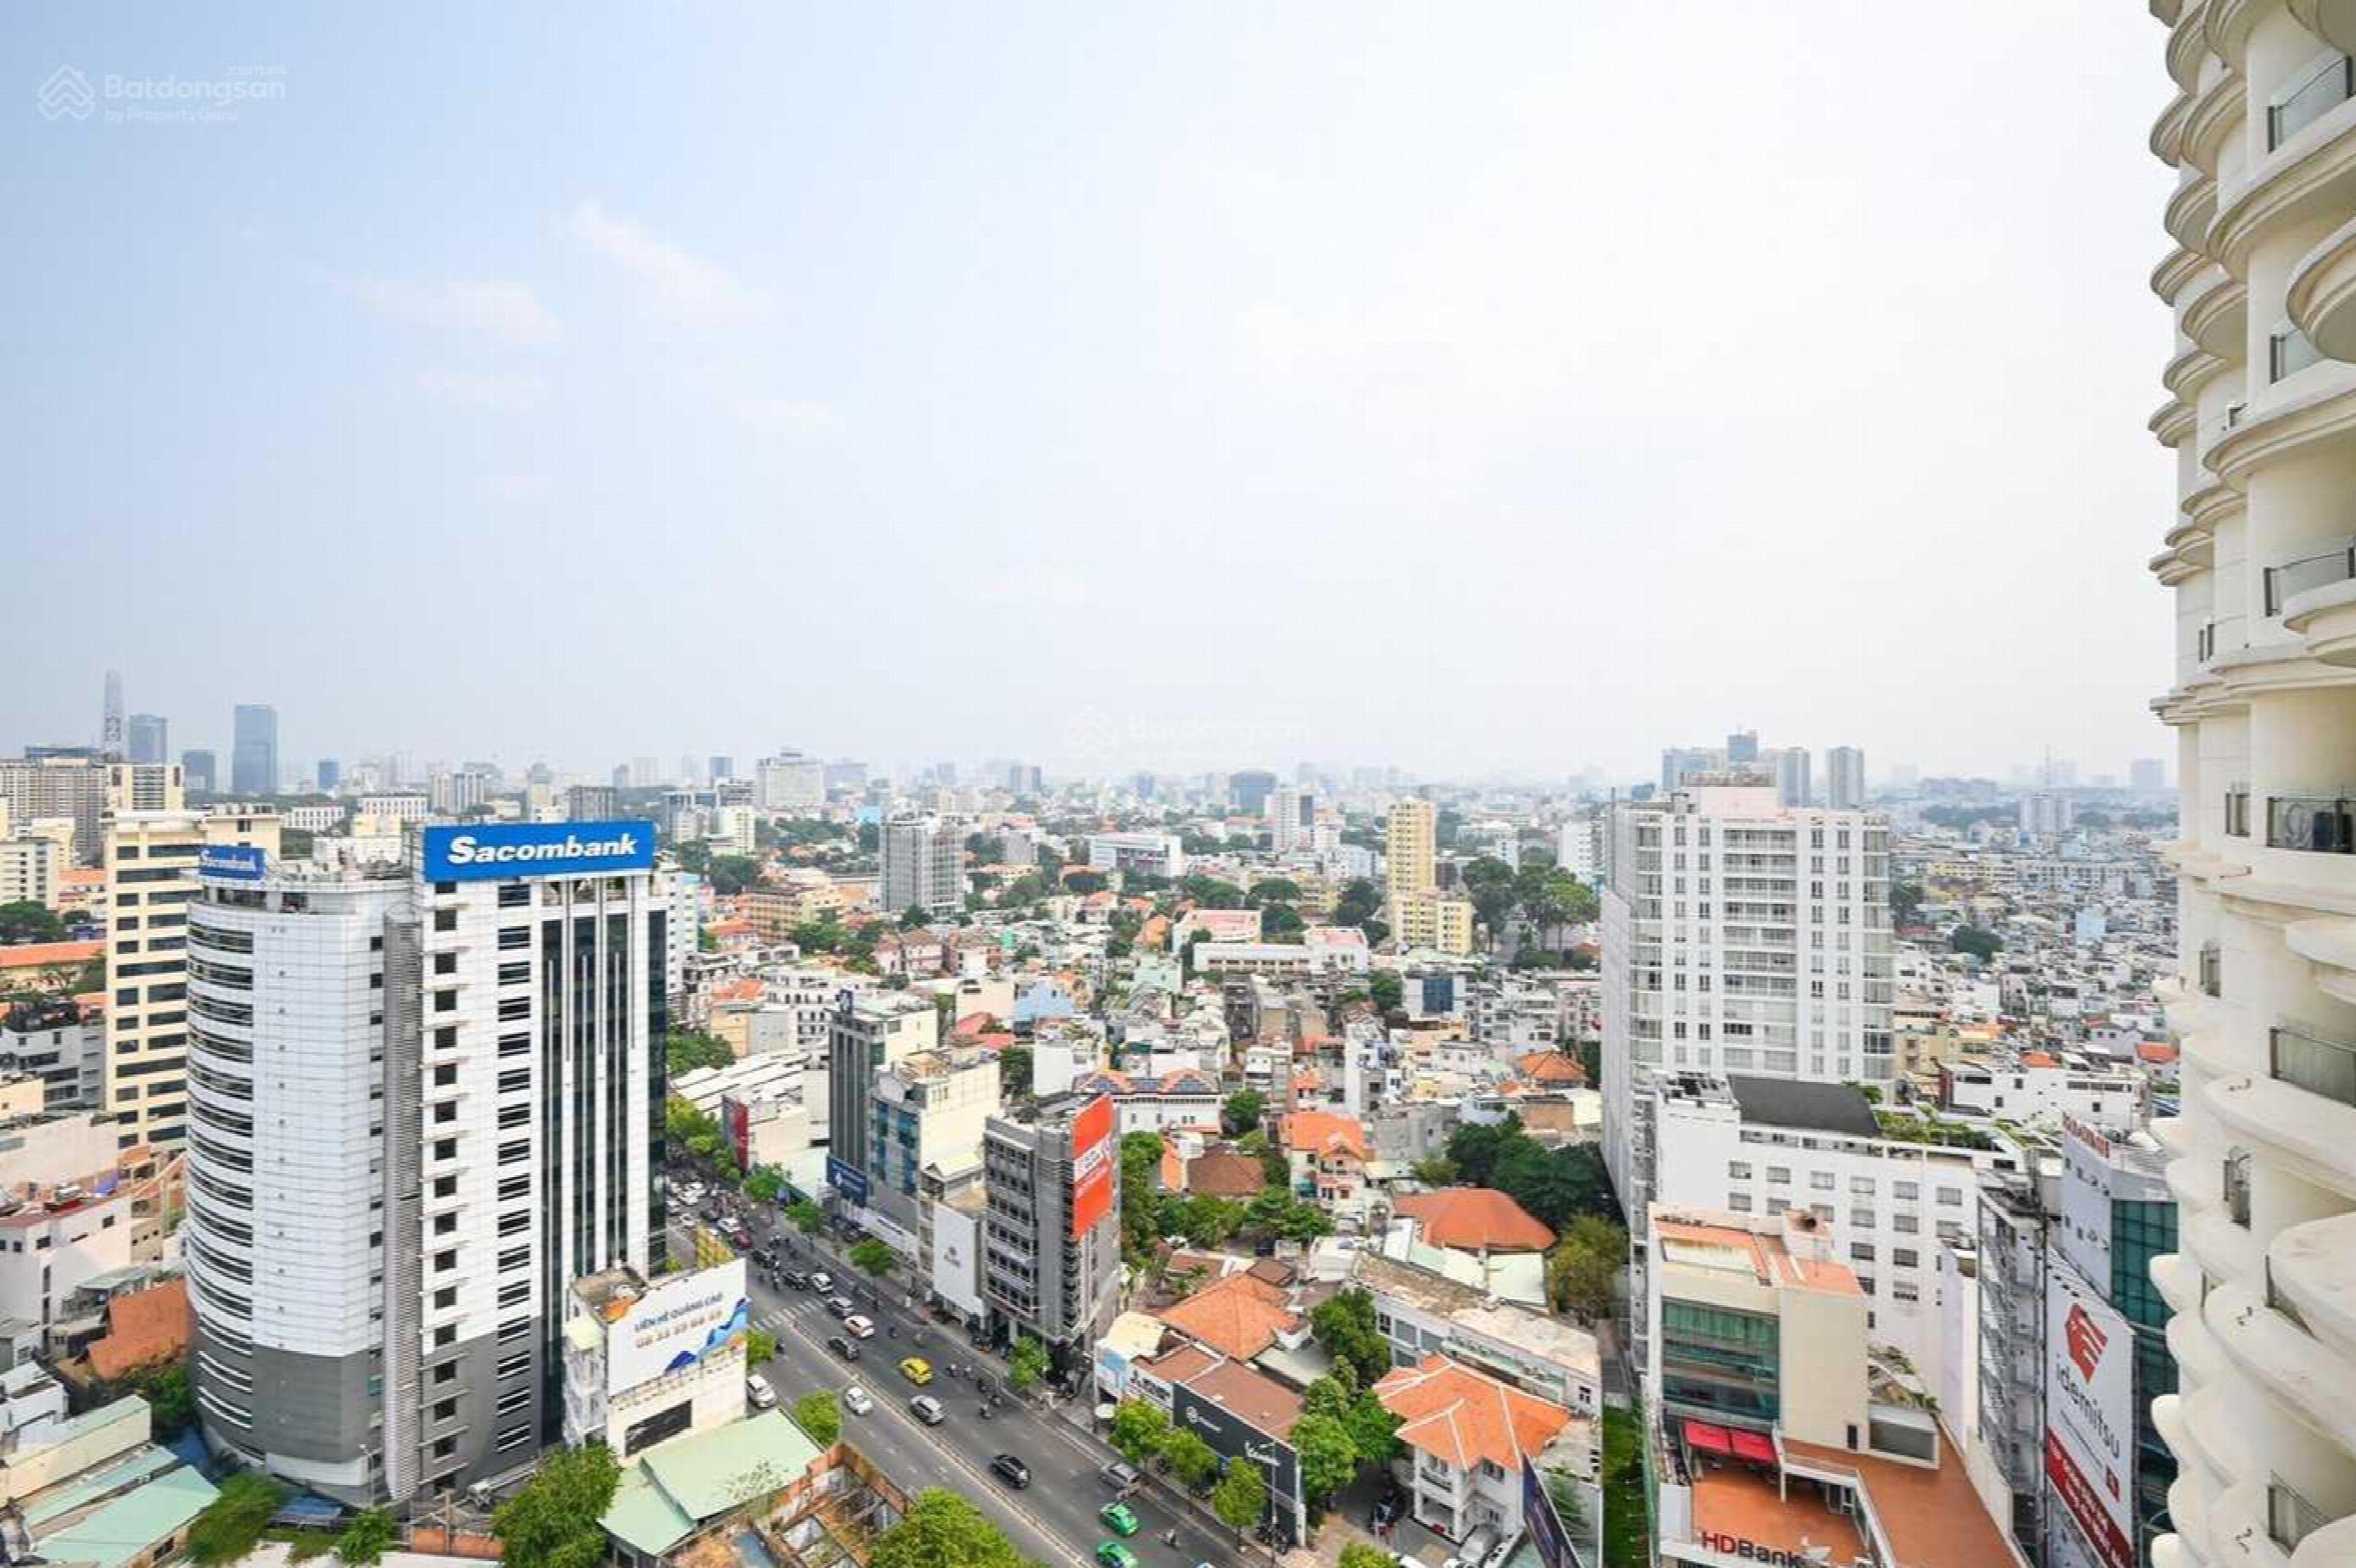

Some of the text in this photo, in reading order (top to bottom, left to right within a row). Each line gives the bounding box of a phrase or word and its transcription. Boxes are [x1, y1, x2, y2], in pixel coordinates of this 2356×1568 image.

[448, 834, 638, 864] Sacombank
[2056, 1353, 2120, 1459] idemitsu
[1700, 1530, 1806, 1568] HDBank
